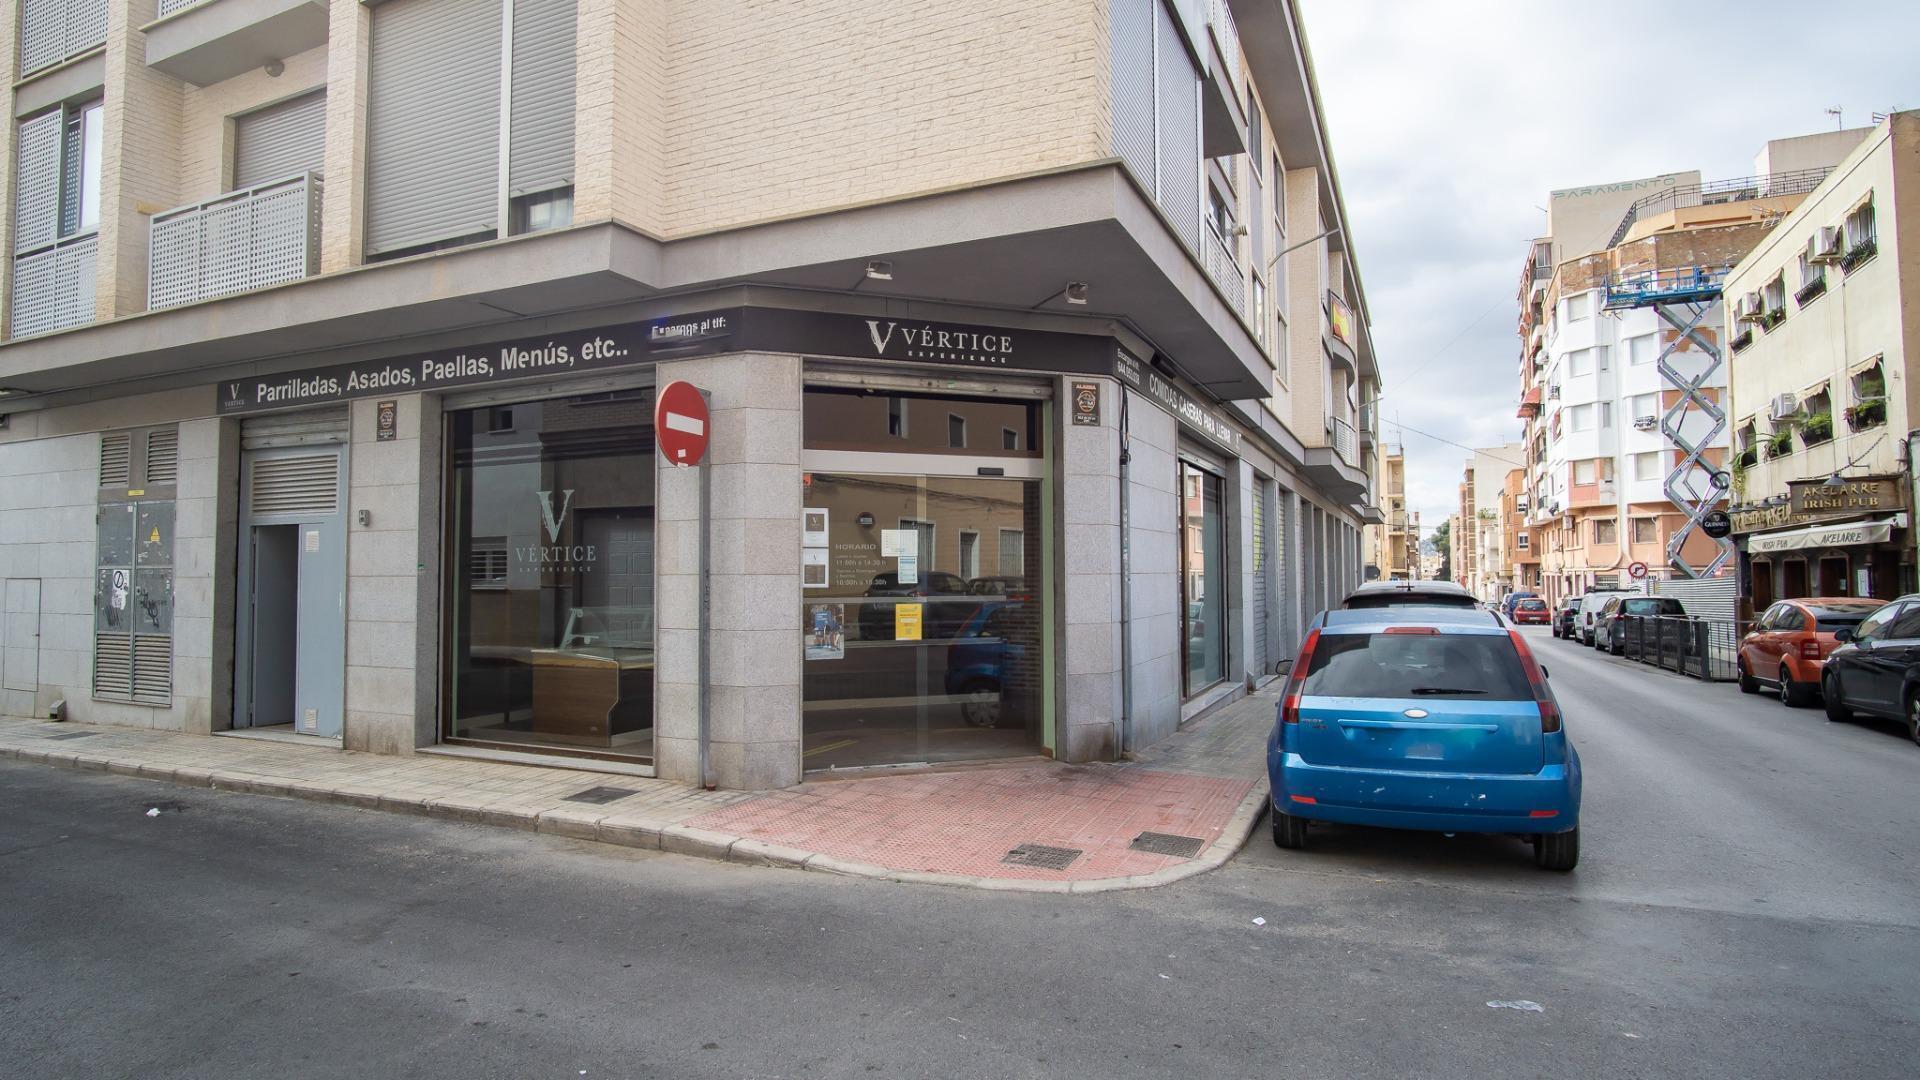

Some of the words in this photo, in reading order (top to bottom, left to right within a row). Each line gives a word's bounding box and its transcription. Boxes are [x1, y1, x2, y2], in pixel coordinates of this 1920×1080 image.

[1553, 178, 1675, 200] PARAMENTO
[713, 317, 726, 328] tlf:
[865, 320, 896, 354] V
[902, 326, 1013, 352] VÉRTICE
[908, 350, 1006, 363] EXPERIENCE
[257, 376, 341, 402] Parrilladas,
[347, 366, 415, 391] Asados,
[422, 355, 494, 381] Paellas,
[501, 342, 574, 370] Menús,
[581, 336, 628, 360] etc..
[1149, 373, 1178, 409] COMIDAS
[1179, 396, 1203, 426] CASERAS
[1803, 483, 1879, 497] AKELARRE
[1804, 499, 1842, 508] IRISH
[1849, 497, 1878, 506] PUB
[536, 489, 575, 543] V
[835, 543, 877, 551] HORARIO
[1821, 533, 1861, 545] AKELARRE
[515, 544, 596, 562] VÉRTICE
